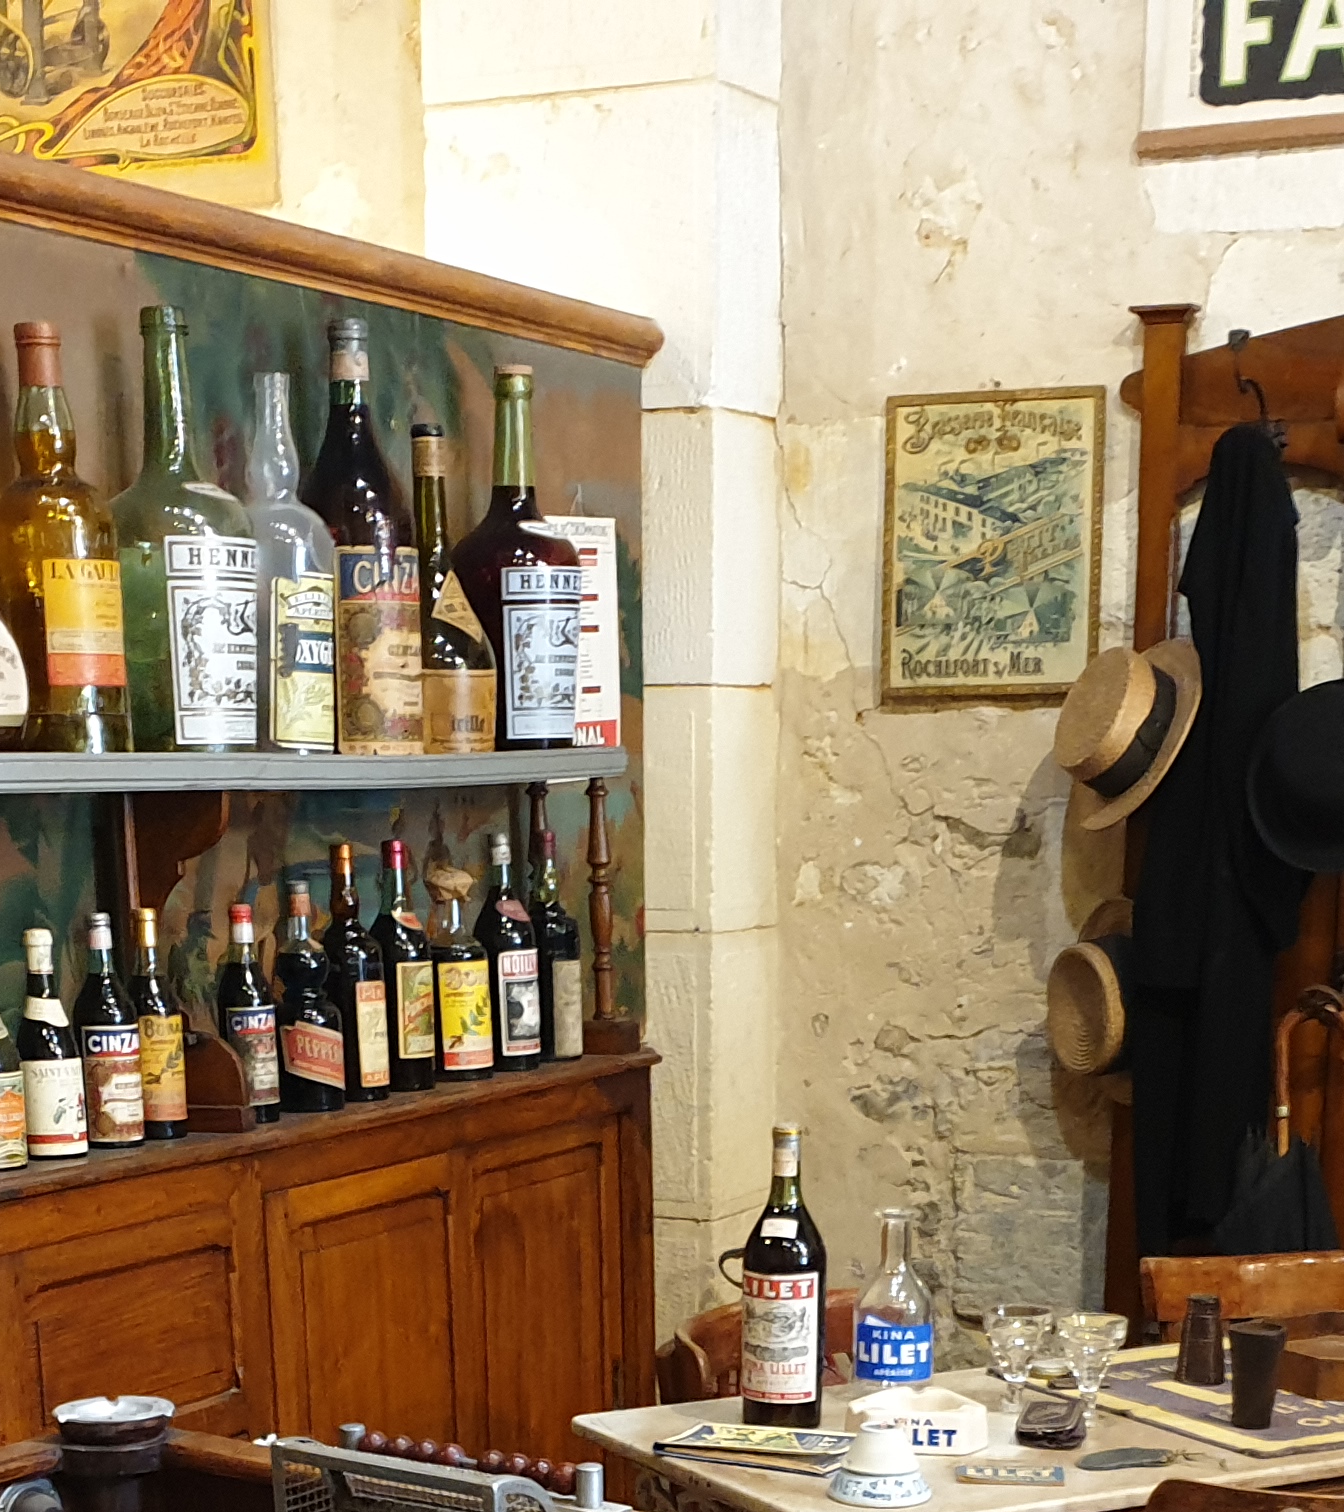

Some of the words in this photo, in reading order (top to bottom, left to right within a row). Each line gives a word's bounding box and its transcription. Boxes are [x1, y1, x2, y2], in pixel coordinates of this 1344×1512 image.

[576, 725, 605, 745] NAL
[872, 1330, 915, 1340] KINA
[858, 1341, 930, 1365] LILET
[912, 1429, 957, 1447] LET
